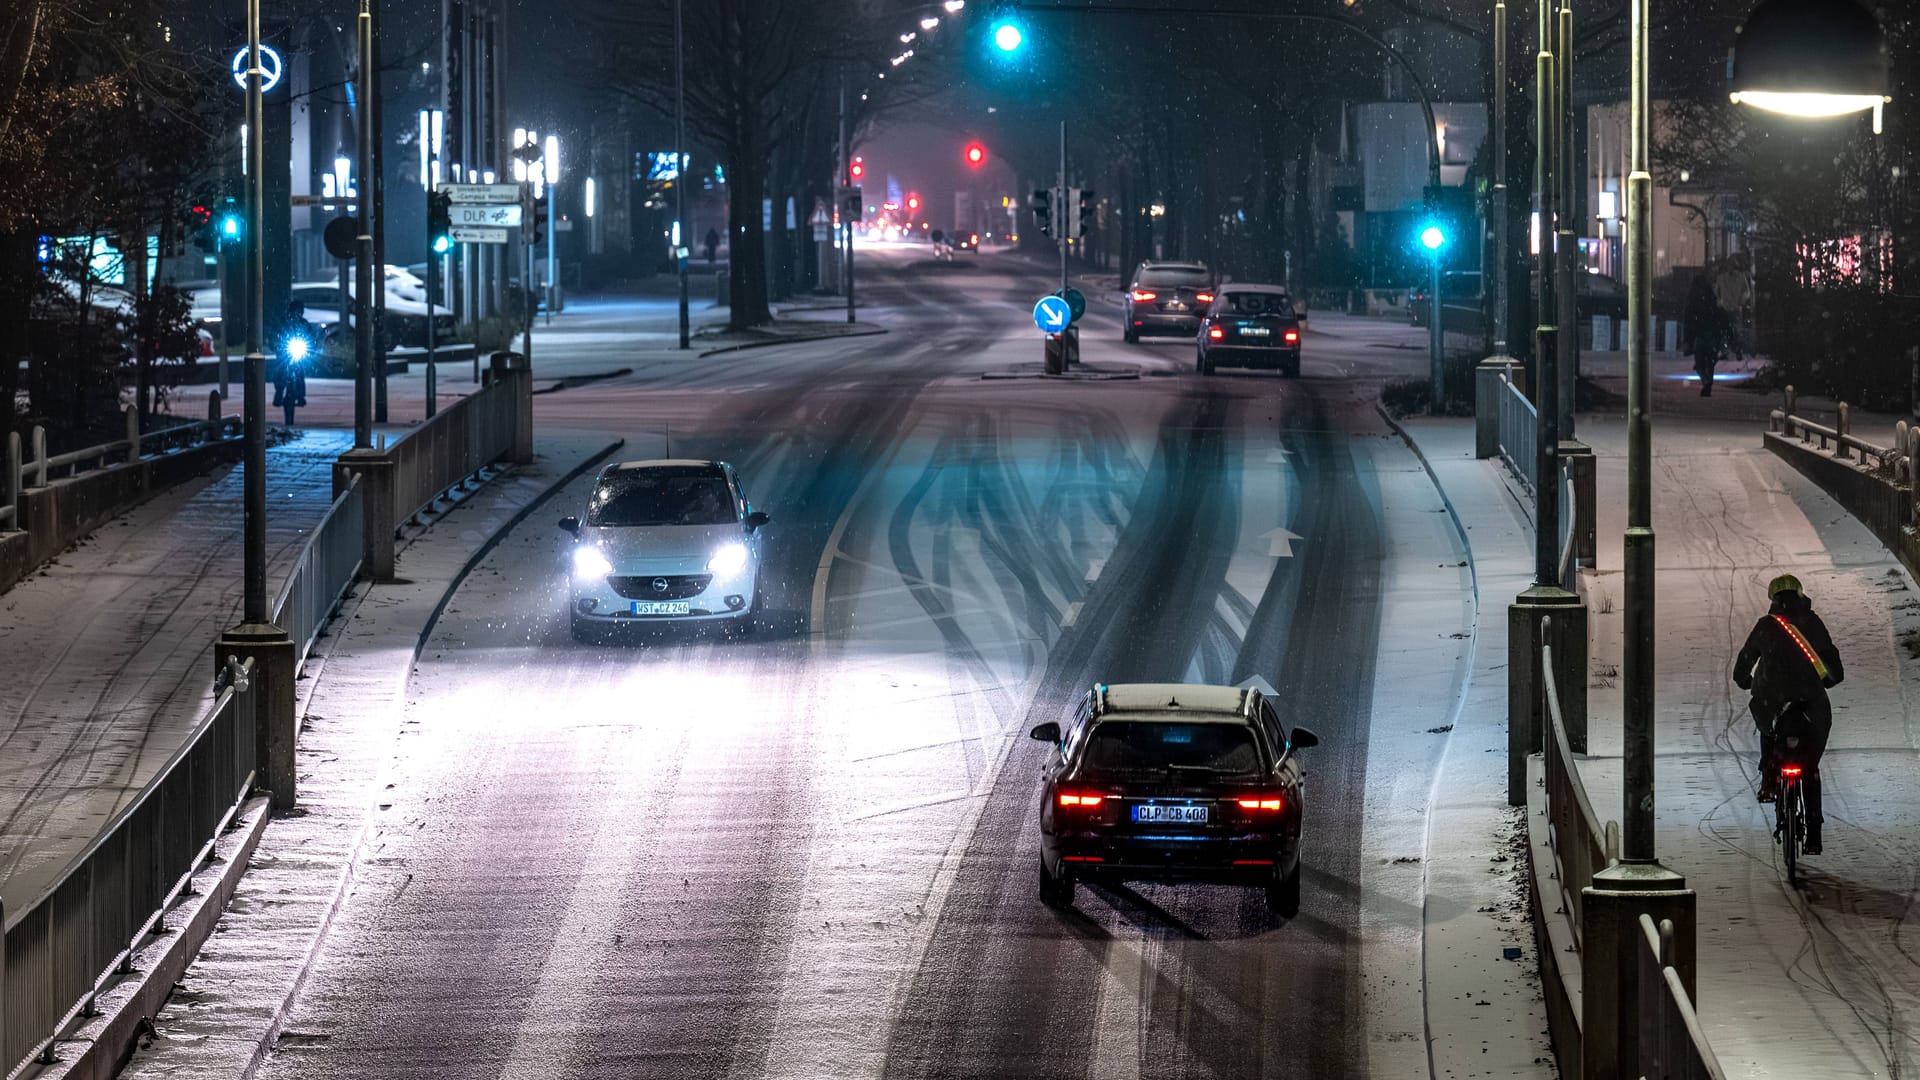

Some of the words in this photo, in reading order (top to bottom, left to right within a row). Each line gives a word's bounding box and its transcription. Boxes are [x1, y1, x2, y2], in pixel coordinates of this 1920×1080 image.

[463, 210, 486, 222] DLR
[638, 603, 654, 613] WST
[659, 603, 671, 613] CZ
[672, 603, 688, 613] 246
[1139, 807, 1161, 820] CLP
[1168, 807, 1182, 820] CB
[1185, 808, 1206, 821] 408
